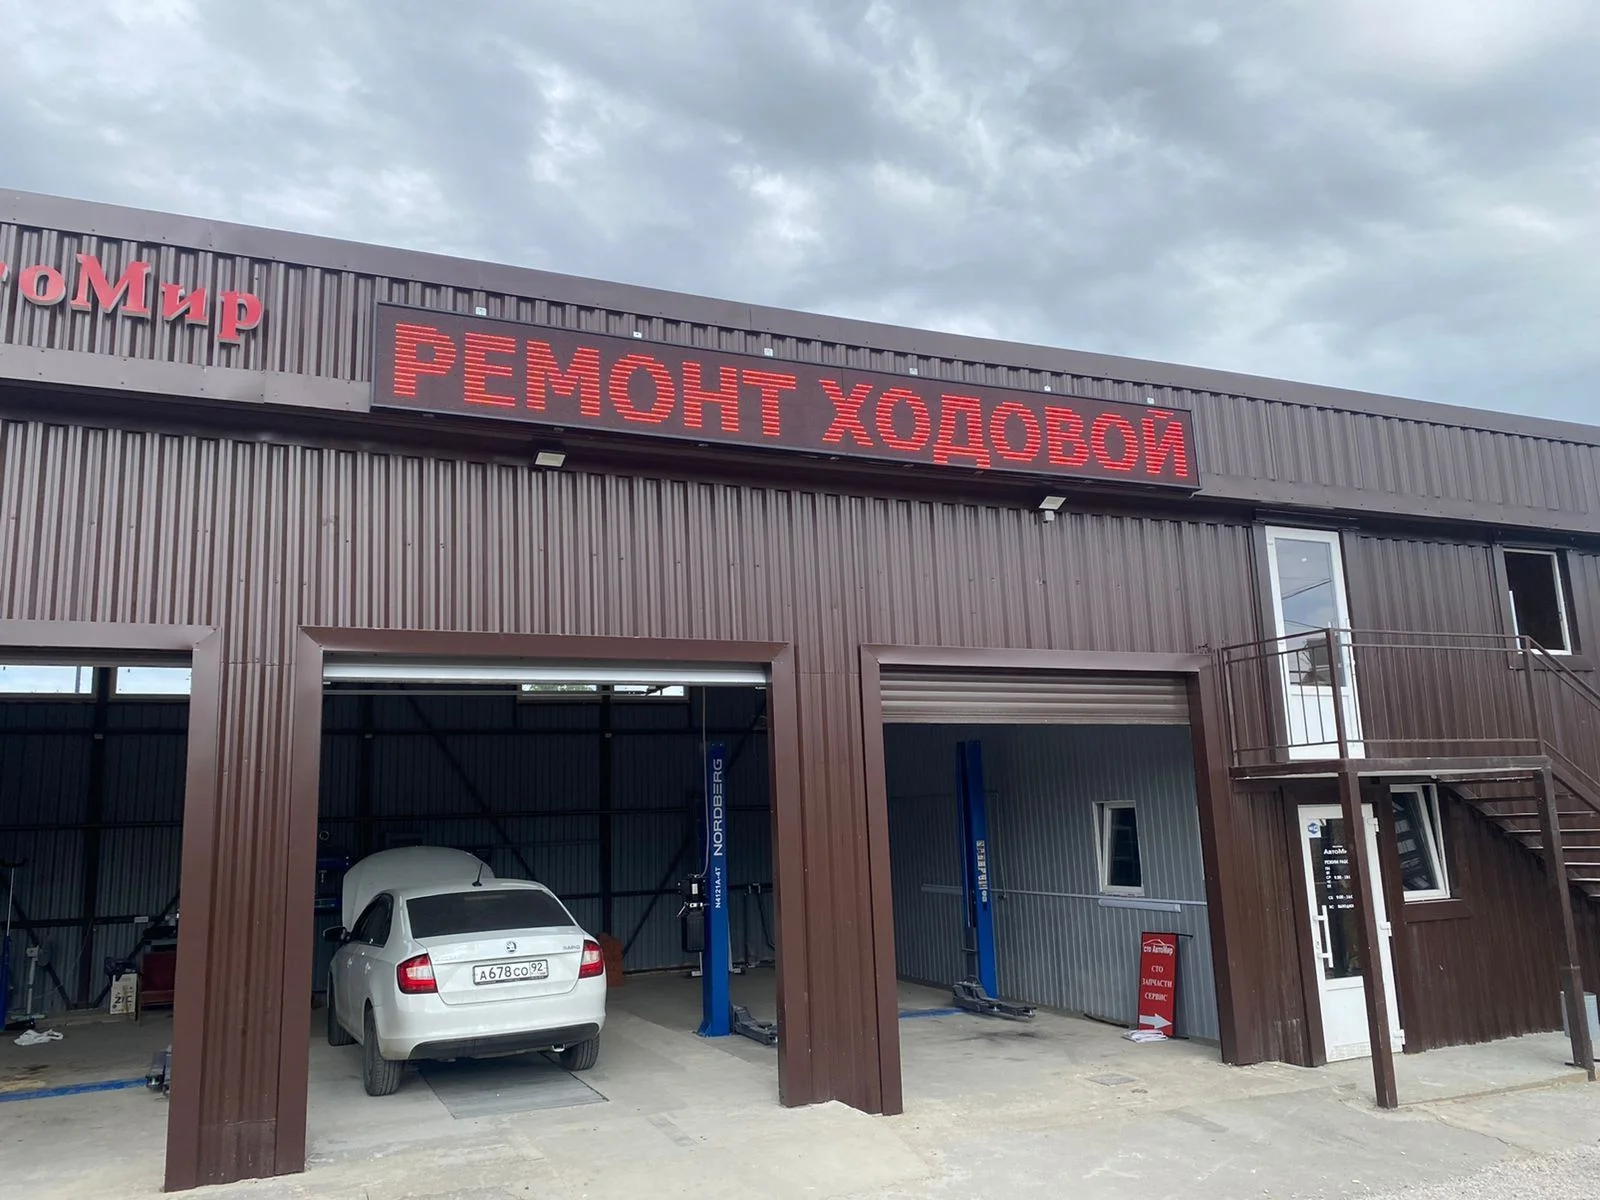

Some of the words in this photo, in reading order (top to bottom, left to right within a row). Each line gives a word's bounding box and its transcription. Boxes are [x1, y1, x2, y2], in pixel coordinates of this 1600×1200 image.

[0, 253, 262, 344] оМир
[394, 323, 797, 436] РЕМОНТ
[818, 379, 1188, 477] ХОДОВОЙ
[713, 758, 723, 857] NORDBERG
[530, 962, 543, 972] 92
[1151, 965, 1164, 973] СТО
[1142, 977, 1173, 988] ЗАПЧАСТИ
[1144, 991, 1168, 1002] СЕРВИС
